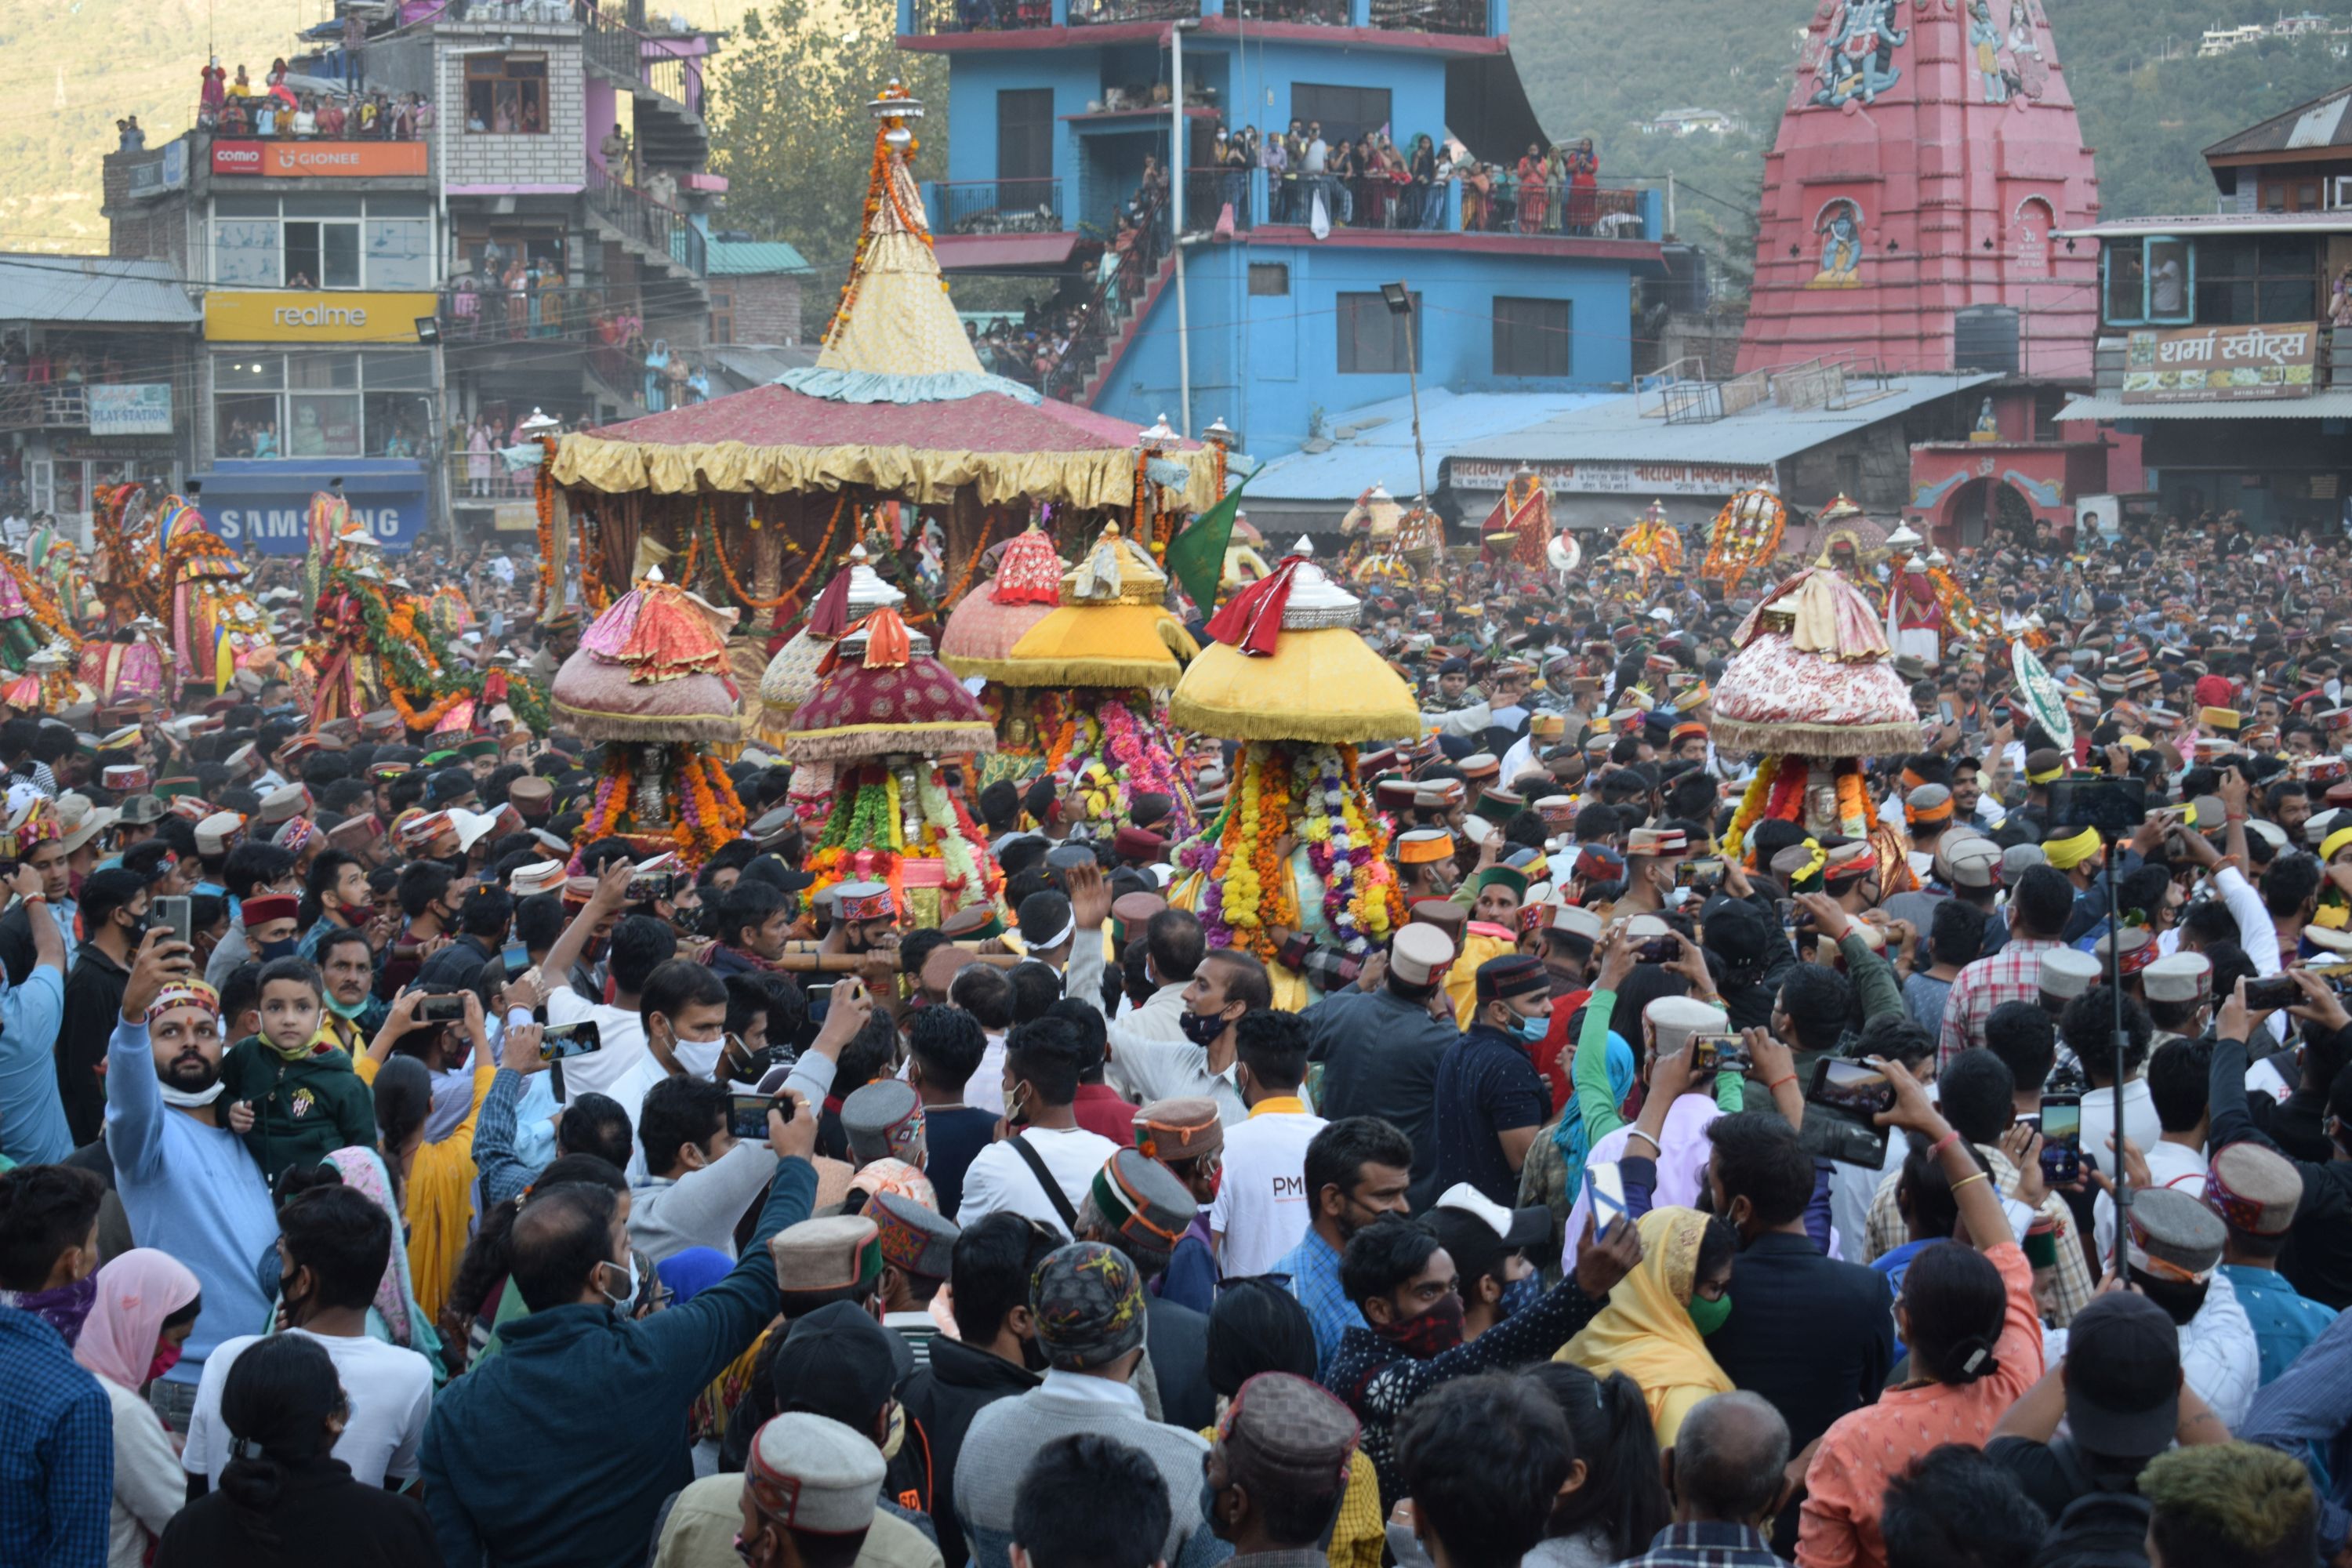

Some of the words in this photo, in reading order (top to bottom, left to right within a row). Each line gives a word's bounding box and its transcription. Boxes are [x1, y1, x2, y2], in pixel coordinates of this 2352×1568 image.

[299, 153, 360, 165] GIONEE
[274, 301, 367, 327] realme
[2159, 328, 2218, 362] शर्मा
[93, 409, 118, 422] PLAY
[122, 408, 167, 421] STATION
[220, 509, 399, 538] SAMNG
